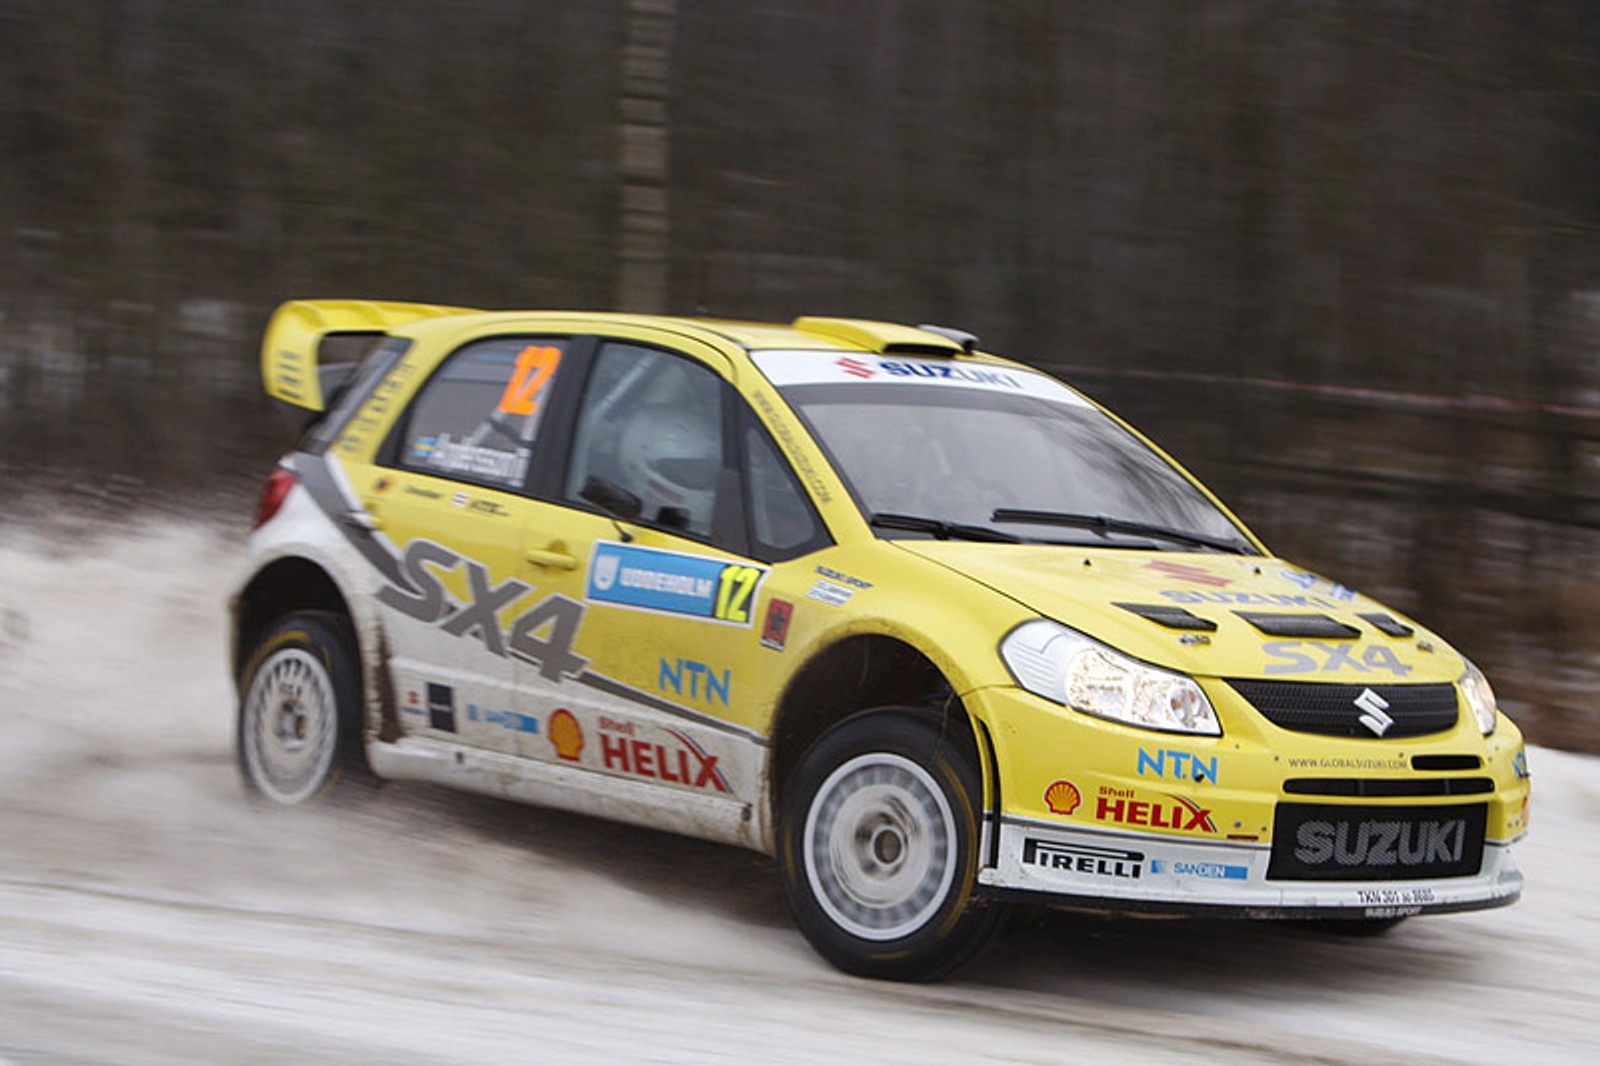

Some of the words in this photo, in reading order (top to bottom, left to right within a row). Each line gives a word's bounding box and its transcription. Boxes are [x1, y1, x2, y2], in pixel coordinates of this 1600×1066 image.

[499, 345, 562, 415] 12
[879, 361, 1022, 389] SUZUKI
[375, 537, 590, 683] SX4
[714, 564, 761, 623] 12
[1158, 589, 1339, 610] SUZUKI
[1261, 641, 1413, 678] SX4
[659, 657, 731, 708] NTN
[597, 715, 634, 735] Shell
[599, 731, 731, 794] HELIX
[1137, 747, 1218, 785] NTN
[1099, 785, 1135, 799] Shell
[1095, 796, 1217, 834] HELIX
[1022, 836, 1145, 880] PIRELLI
[1294, 818, 1467, 866] SUZUKI
[1173, 861, 1226, 879] SANDEN
